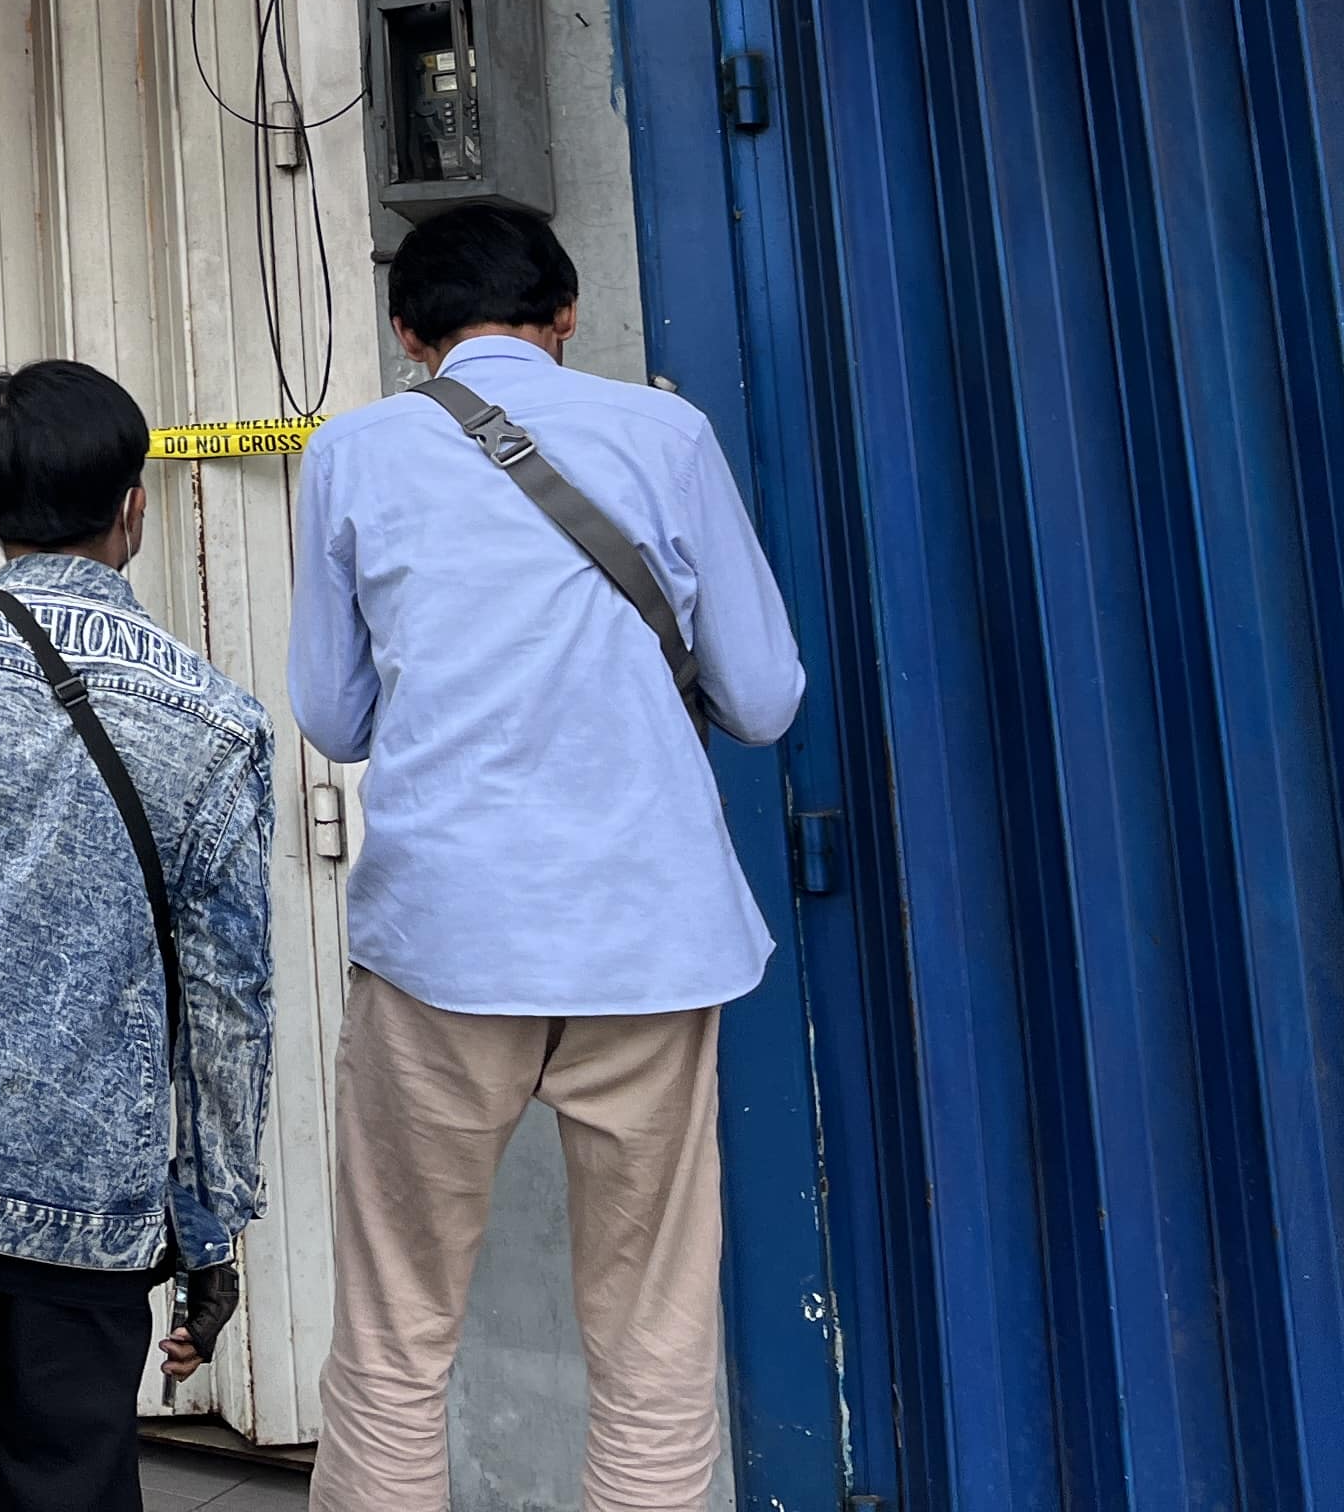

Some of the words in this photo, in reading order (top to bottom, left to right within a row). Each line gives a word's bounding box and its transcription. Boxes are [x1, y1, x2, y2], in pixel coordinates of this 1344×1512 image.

[164, 437, 188, 454] DO
[197, 435, 231, 454] NOT
[239, 434, 302, 453] CROSS
